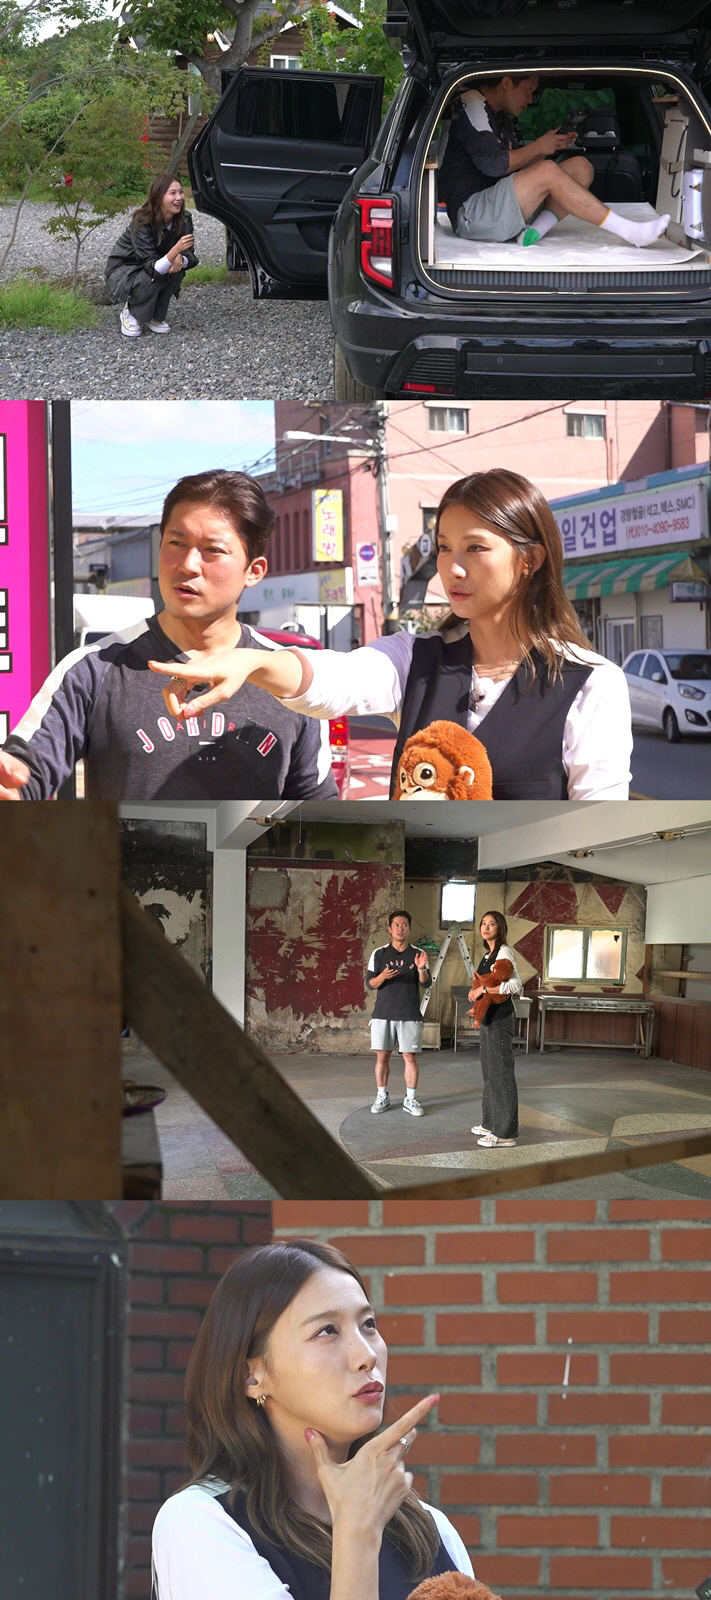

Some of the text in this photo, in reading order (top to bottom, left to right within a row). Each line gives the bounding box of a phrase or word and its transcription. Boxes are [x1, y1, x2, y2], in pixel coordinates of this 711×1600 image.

[321, 508, 337, 557] 노래방
[560, 507, 617, 553] 일건업
[136, 712, 278, 758] JORDN
